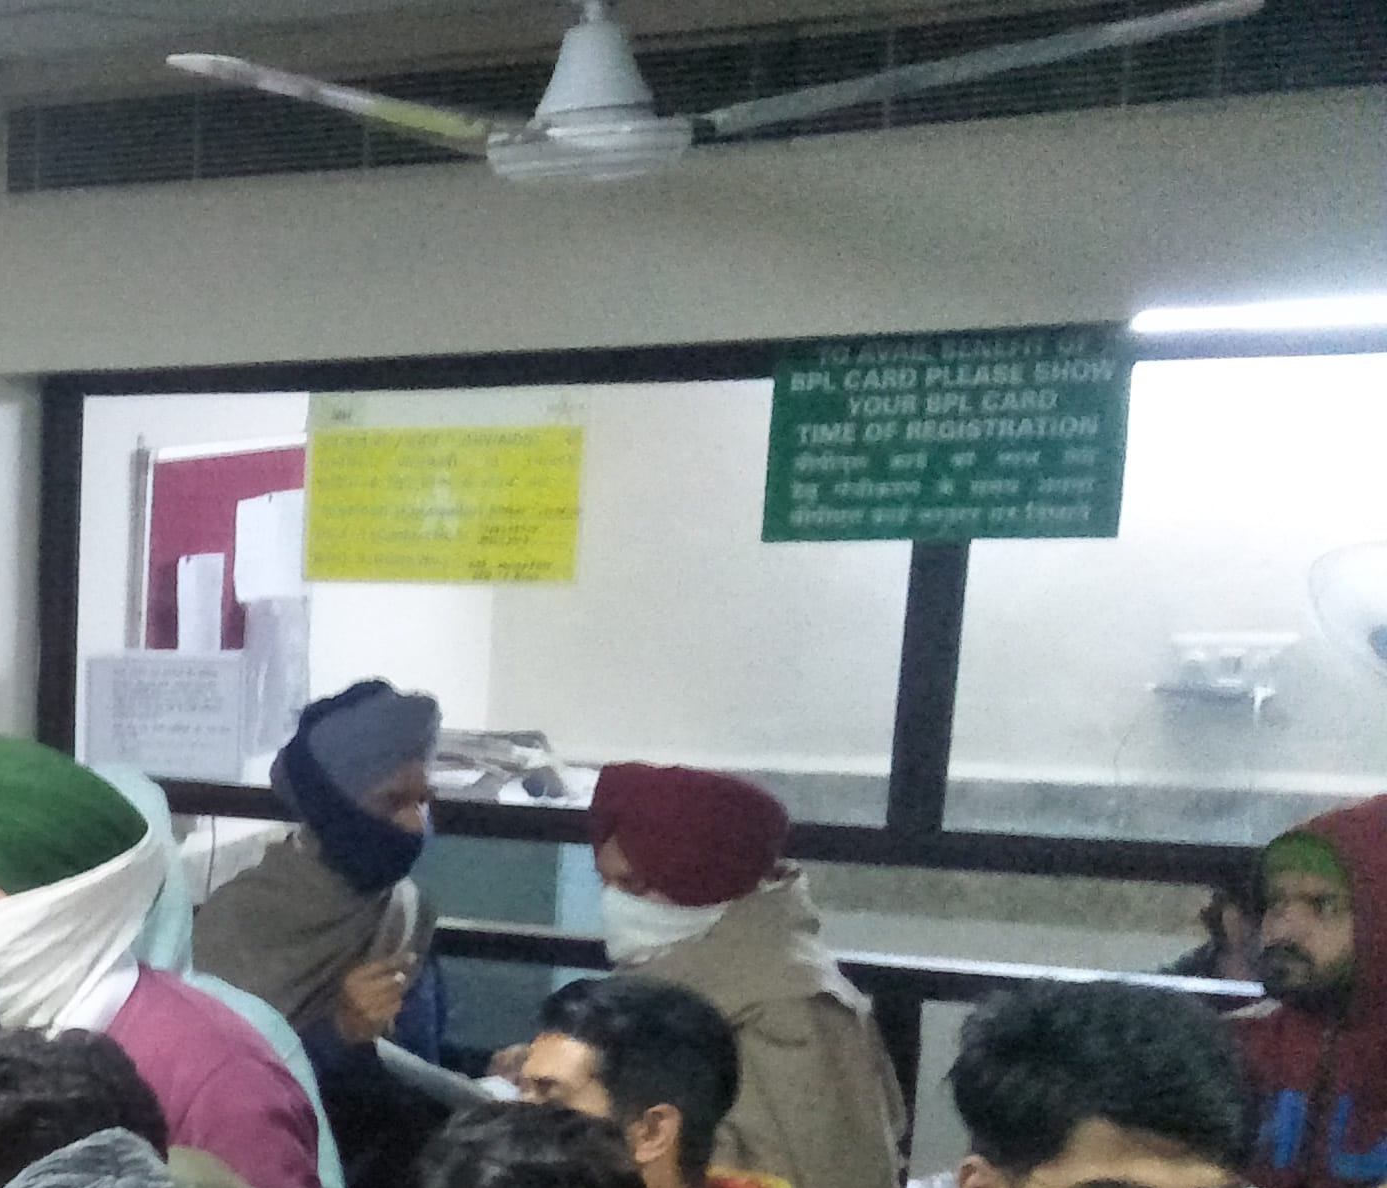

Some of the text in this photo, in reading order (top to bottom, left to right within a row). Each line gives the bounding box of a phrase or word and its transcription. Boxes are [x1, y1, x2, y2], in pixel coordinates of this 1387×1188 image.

[843, 367, 917, 390] CARD
[925, 363, 1025, 387] PLEASE
[1034, 359, 1116, 382] SHOW
[847, 389, 1058, 416] YOUR BPL CARD
[796, 415, 1099, 445] TIME OF REGISTRATION
